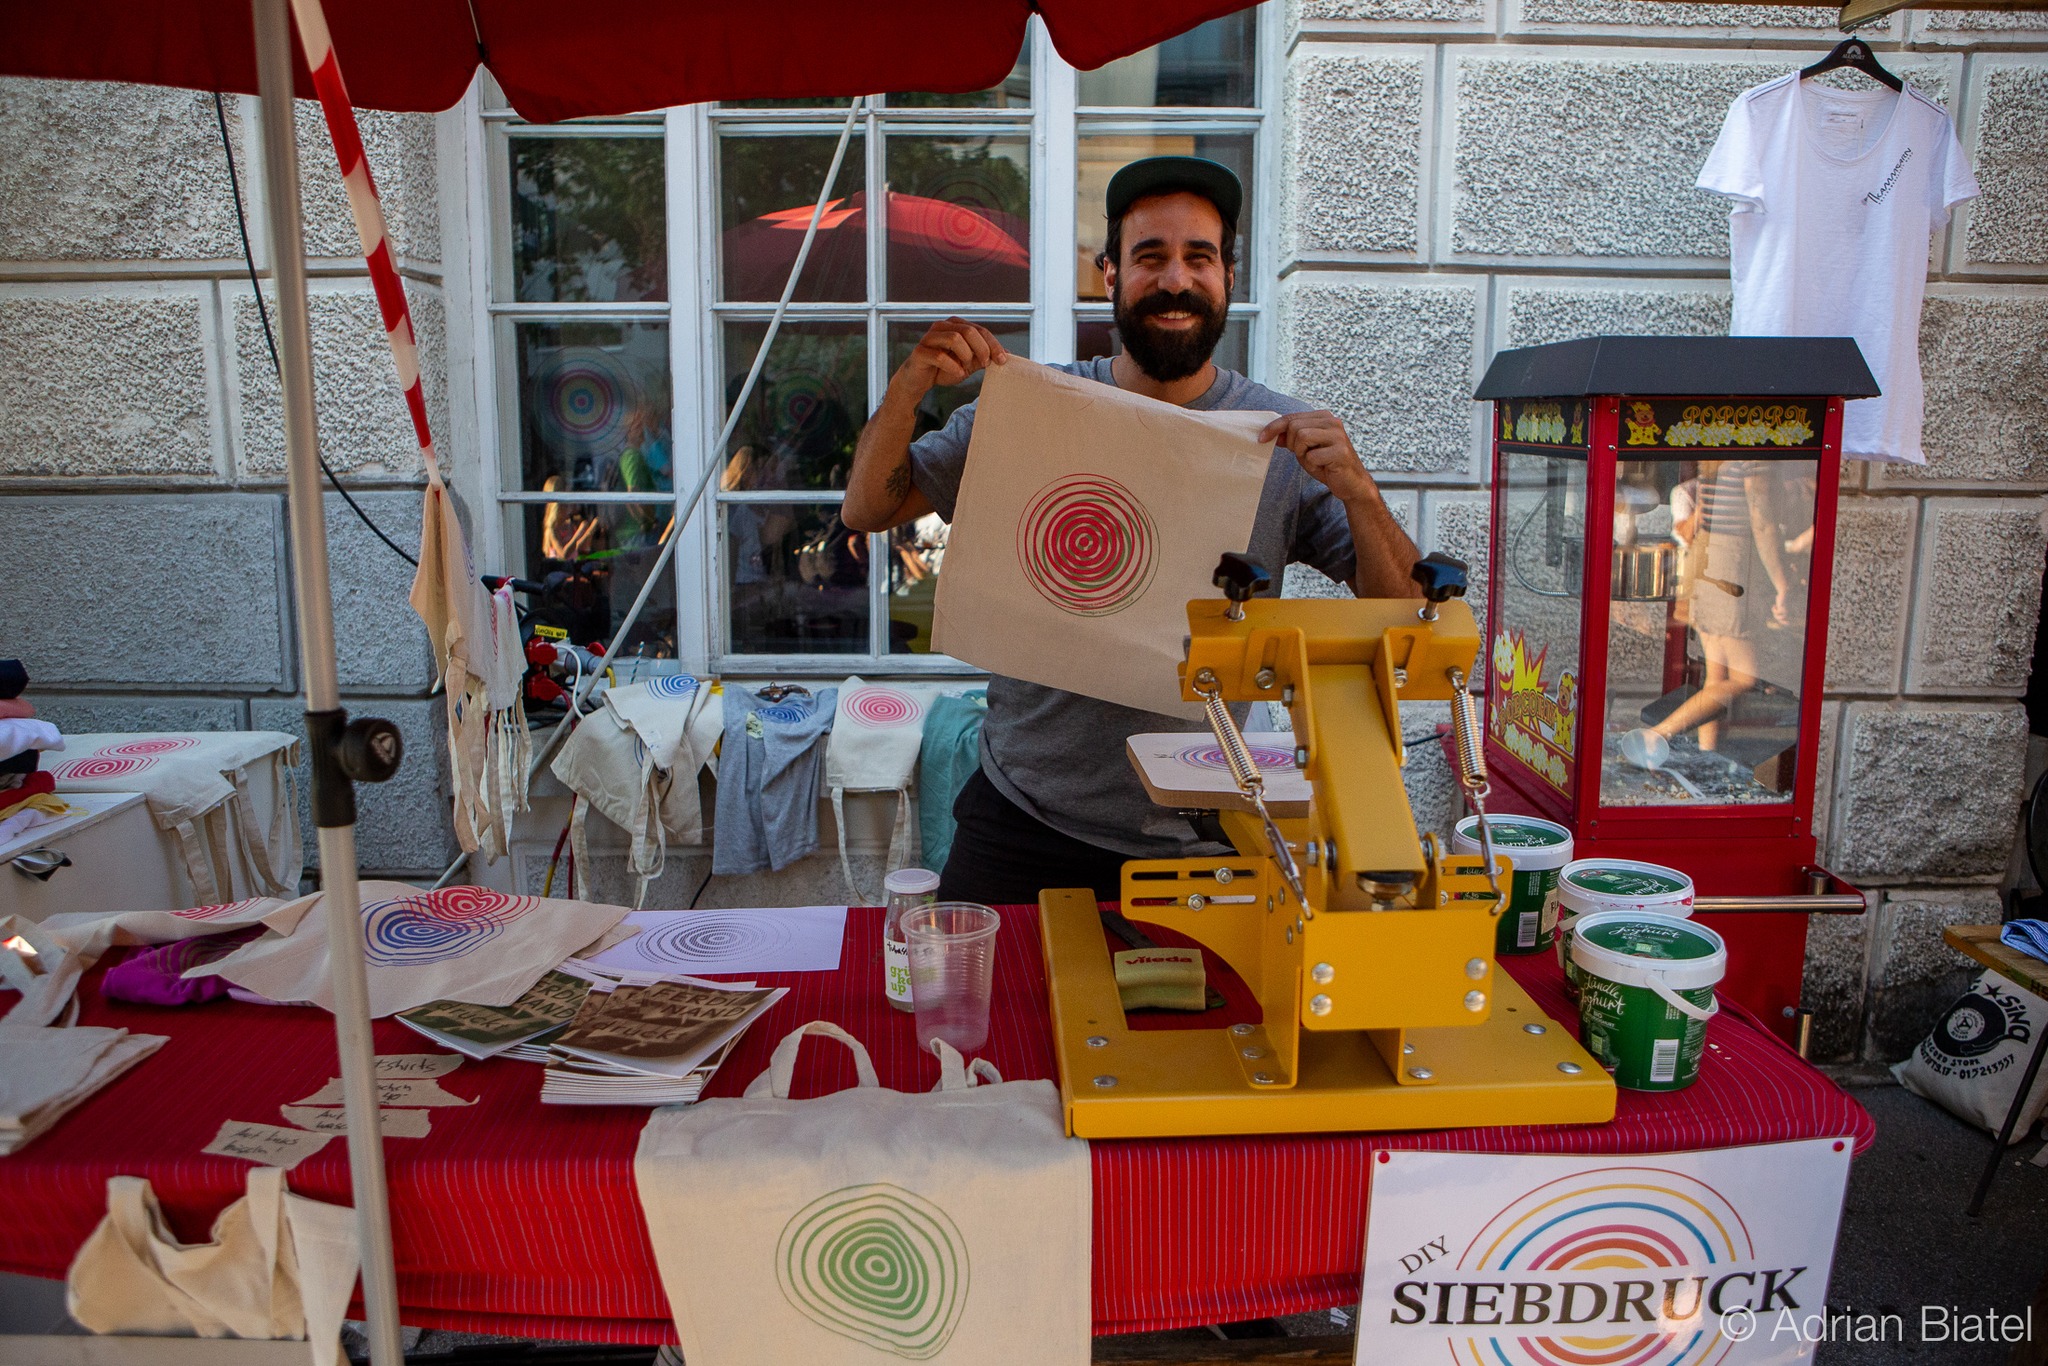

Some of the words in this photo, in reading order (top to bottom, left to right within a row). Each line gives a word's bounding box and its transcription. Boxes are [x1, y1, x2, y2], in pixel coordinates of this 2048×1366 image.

[1682, 405, 1812, 428] POPCORN
[1125, 955, 1193, 966] vileda
[653, 986, 738, 1008] FERDI
[661, 1003, 746, 1020] NAND
[1398, 1234, 1452, 1276] DIY
[1389, 1265, 1808, 1326] SIEBDRUCK
